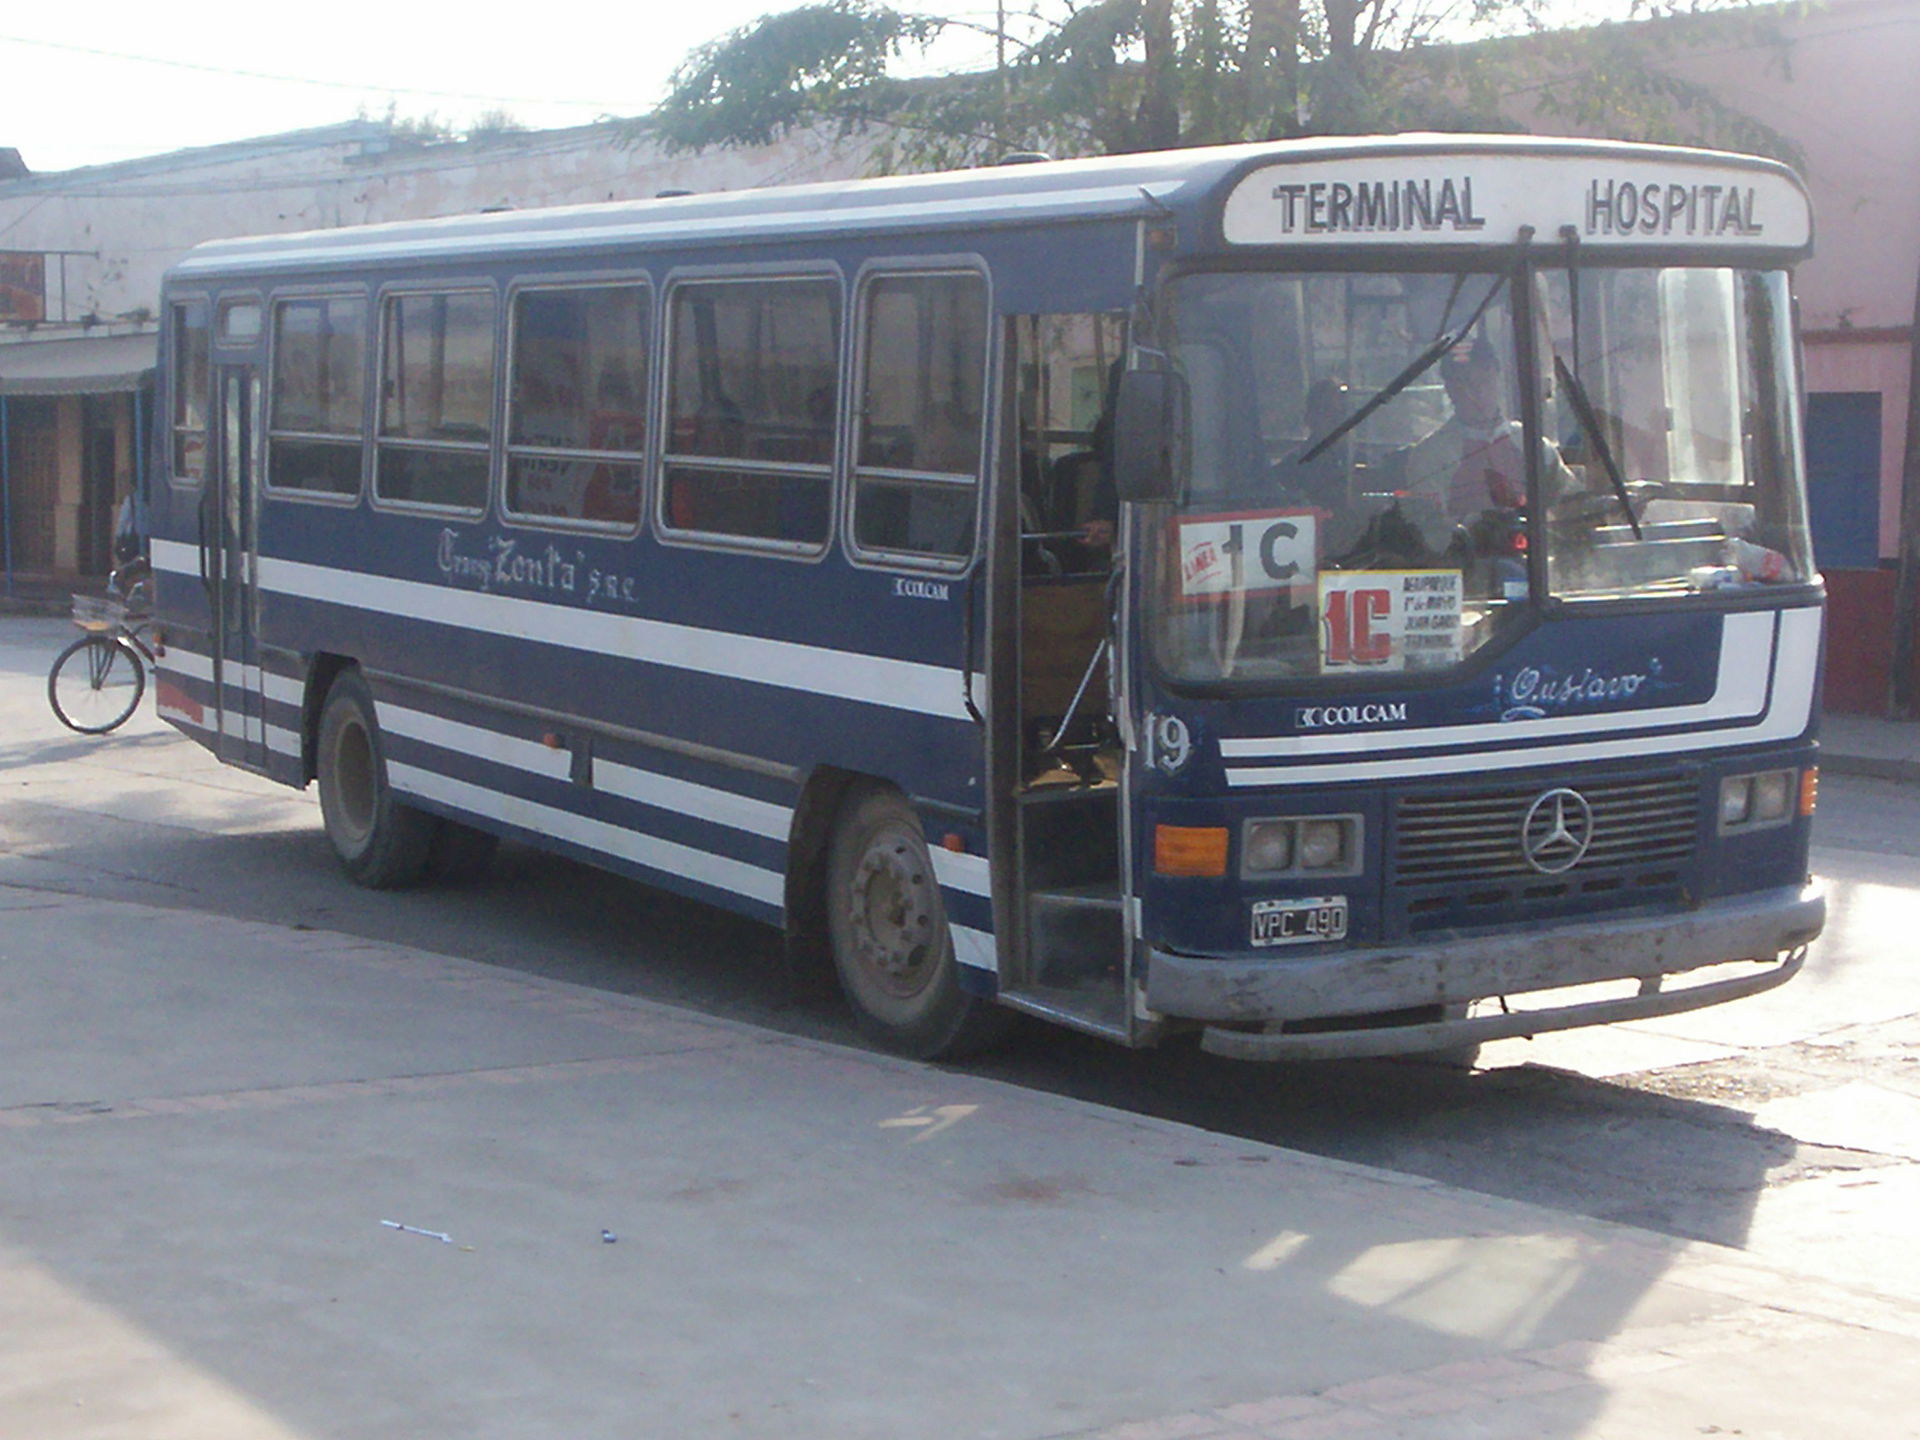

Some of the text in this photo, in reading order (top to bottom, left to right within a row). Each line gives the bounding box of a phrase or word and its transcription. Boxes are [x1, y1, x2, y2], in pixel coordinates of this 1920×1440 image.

[1275, 177, 1485, 233] TERMINAL
[1586, 179, 1763, 234] HOSPITAL
[1326, 589, 1391, 665] 1C
[1145, 711, 1191, 770] 19
[1323, 703, 1407, 726] COLCAM
[1305, 907, 1345, 935] 490
